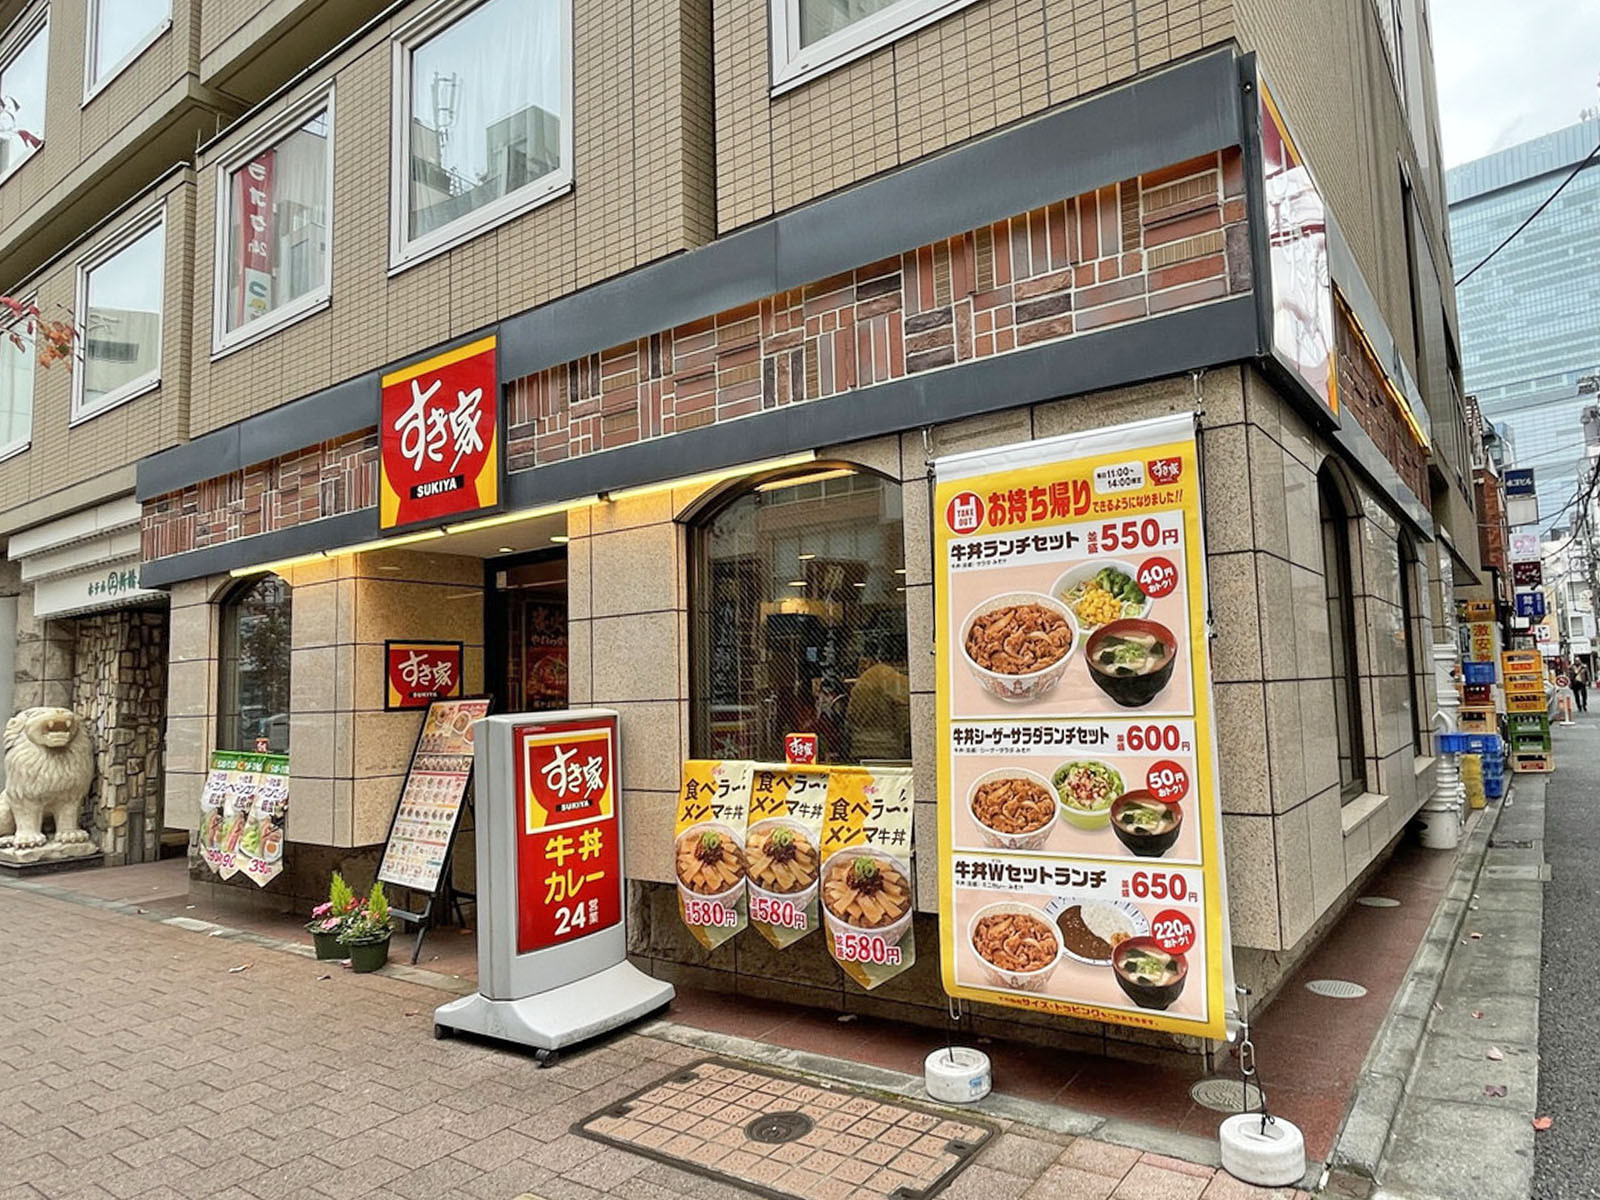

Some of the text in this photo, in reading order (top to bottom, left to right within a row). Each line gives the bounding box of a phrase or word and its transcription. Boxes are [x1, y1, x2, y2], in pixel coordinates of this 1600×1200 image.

[395, 379, 484, 473] すき家
[416, 476, 458, 498] SUKIYA
[988, 479, 1092, 527] お持ち帰り
[951, 531, 1080, 561] 牛丼ランチセット
[1100, 518, 1179, 552] 550円
[1140, 565, 1174, 585] 40円
[398, 650, 453, 691] すき家
[953, 726, 1110, 746] 牛丼シーザーサラダランチセット
[1127, 724, 1191, 752] 600円
[540, 745, 605, 799] すき家
[1149, 769, 1185, 789] 50円
[681, 804, 745, 822] メンマ牛丼
[749, 796, 823, 819] メンマ牛丼
[544, 827, 604, 867] 牛丼
[824, 825, 907, 846] メンマ牛丼
[544, 868, 605, 905] カレー
[955, 860, 1107, 889] 牛丼Wセットランチ
[1131, 871, 1198, 903] 650円
[554, 901, 587, 936] 24
[691, 901, 736, 927] 580円
[758, 898, 806, 930] 580円
[1153, 919, 1193, 940] 220円
[845, 934, 900, 964] 580円
